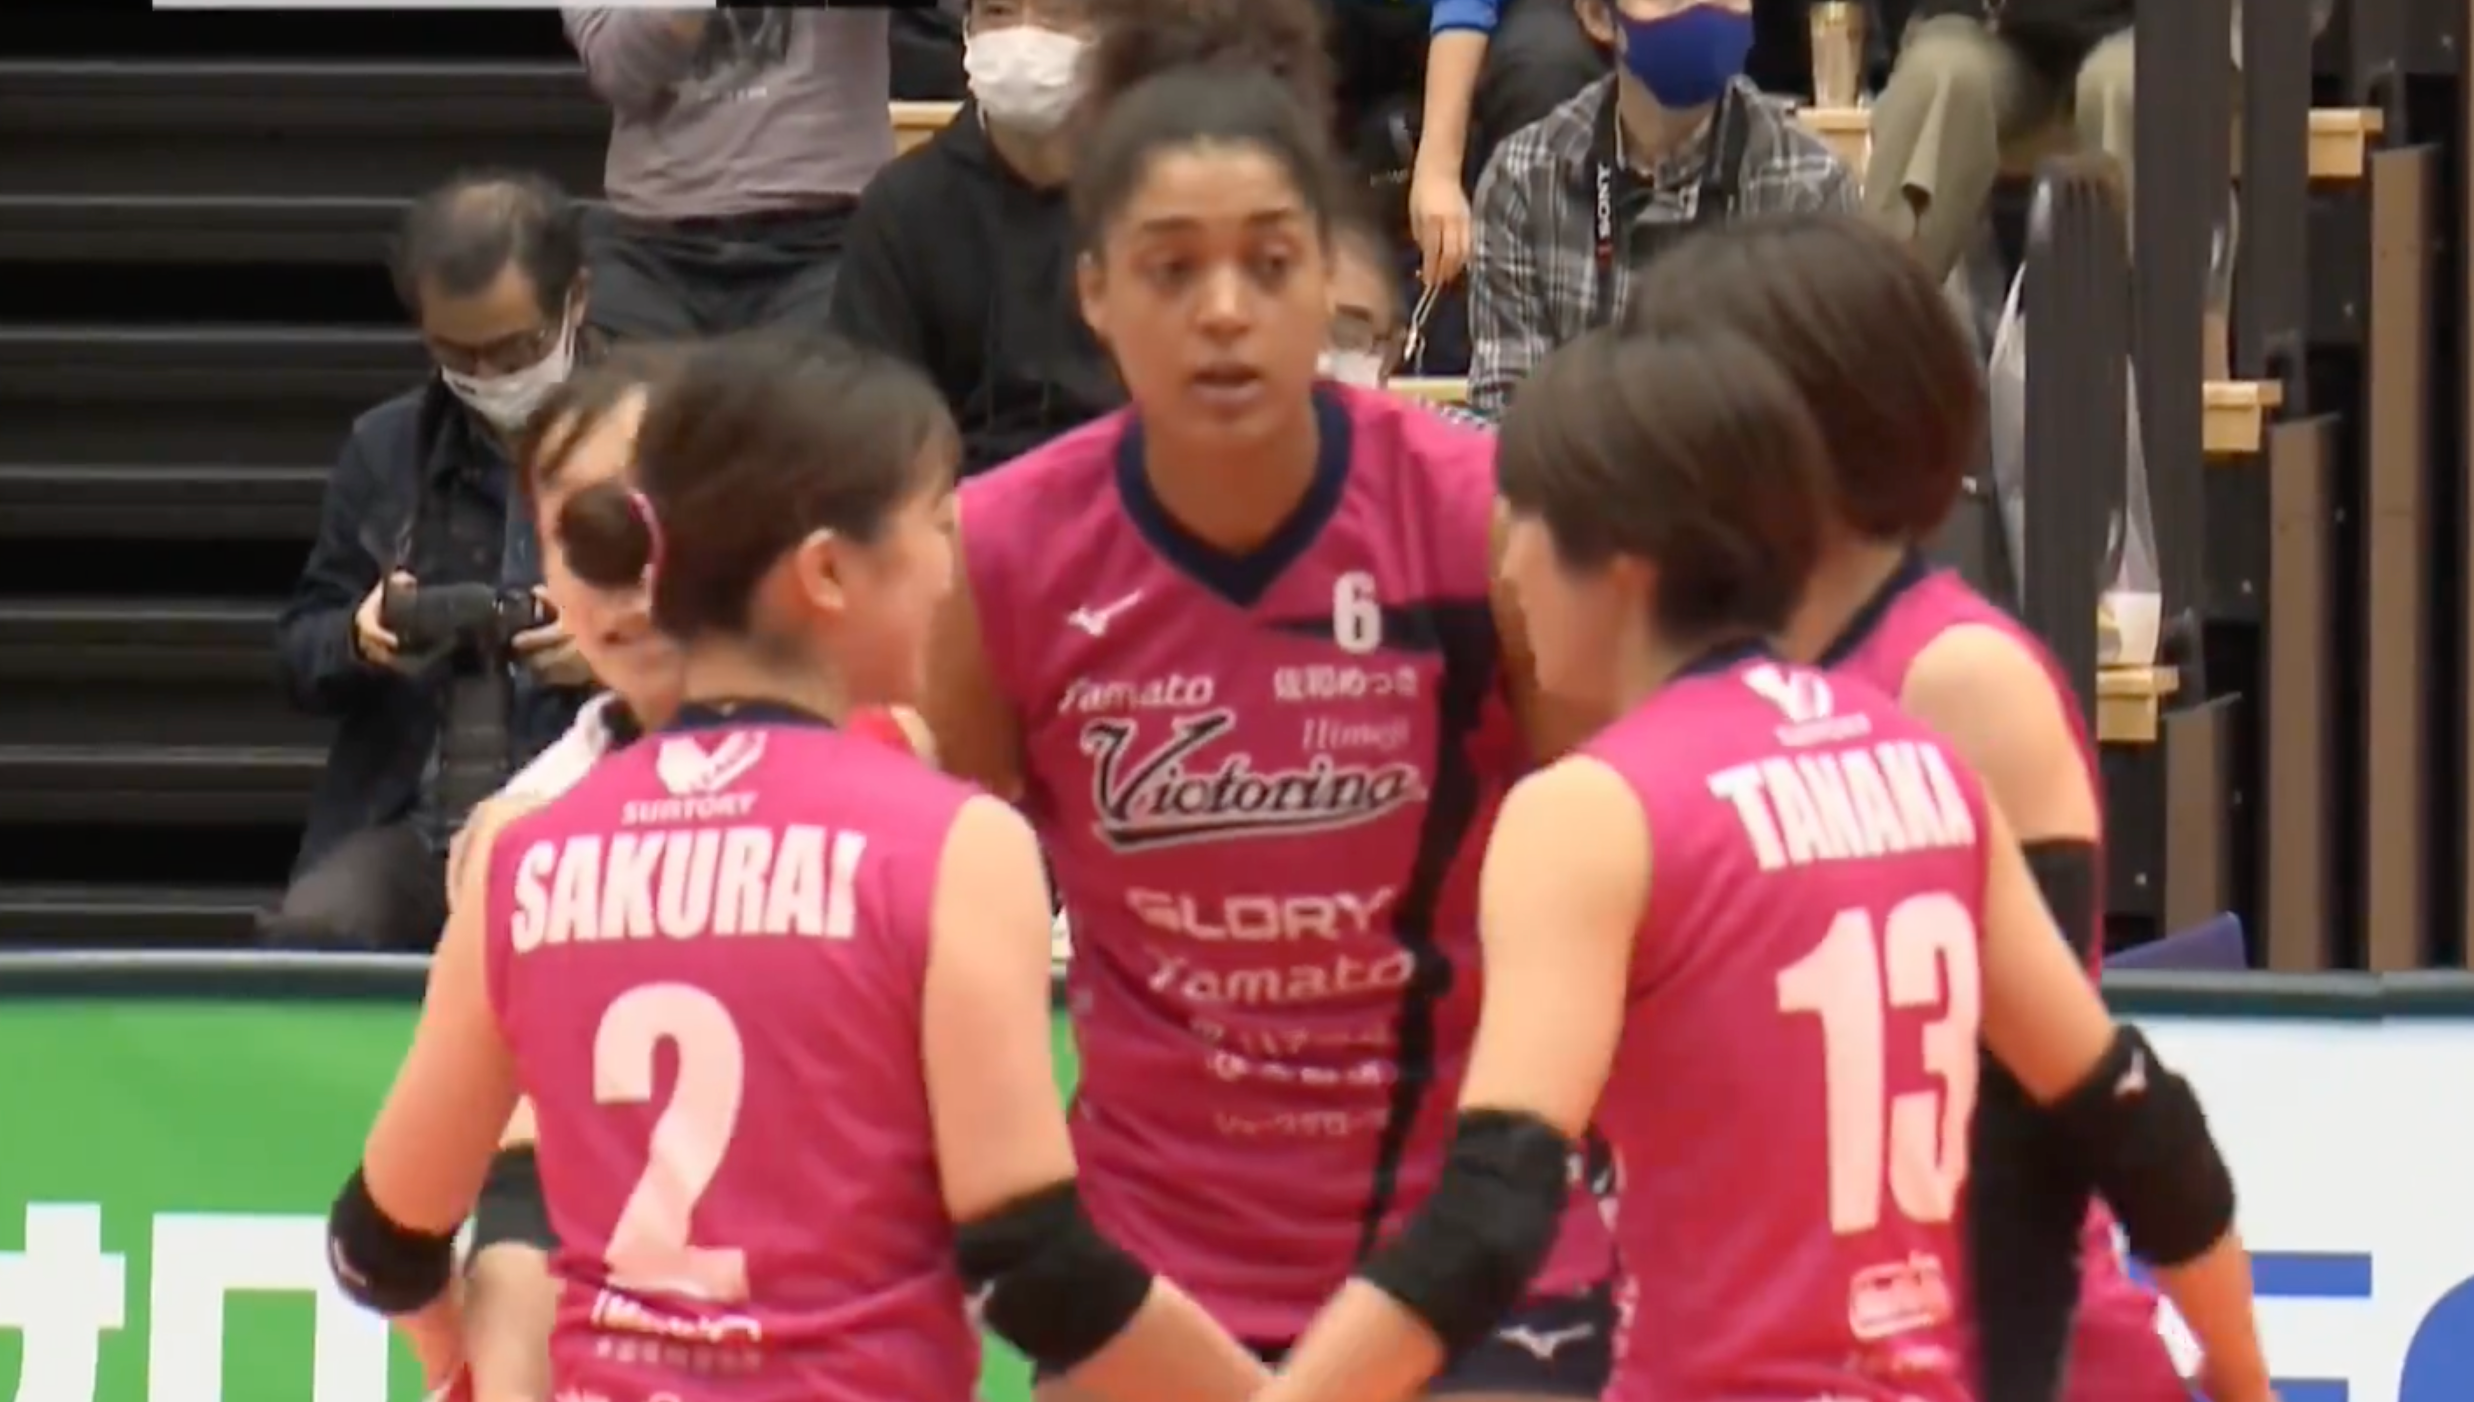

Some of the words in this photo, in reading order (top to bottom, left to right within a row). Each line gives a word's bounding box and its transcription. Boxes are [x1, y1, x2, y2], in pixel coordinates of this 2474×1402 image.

[1335, 573, 1382, 653] 6
[1082, 712, 1425, 850] Victorina
[1707, 740, 1976, 871] TANAKA
[512, 824, 868, 954] SAKURAI
[1126, 888, 1396, 940] GLORY
[1776, 890, 1982, 1234] 13
[593, 982, 750, 1298] 2
